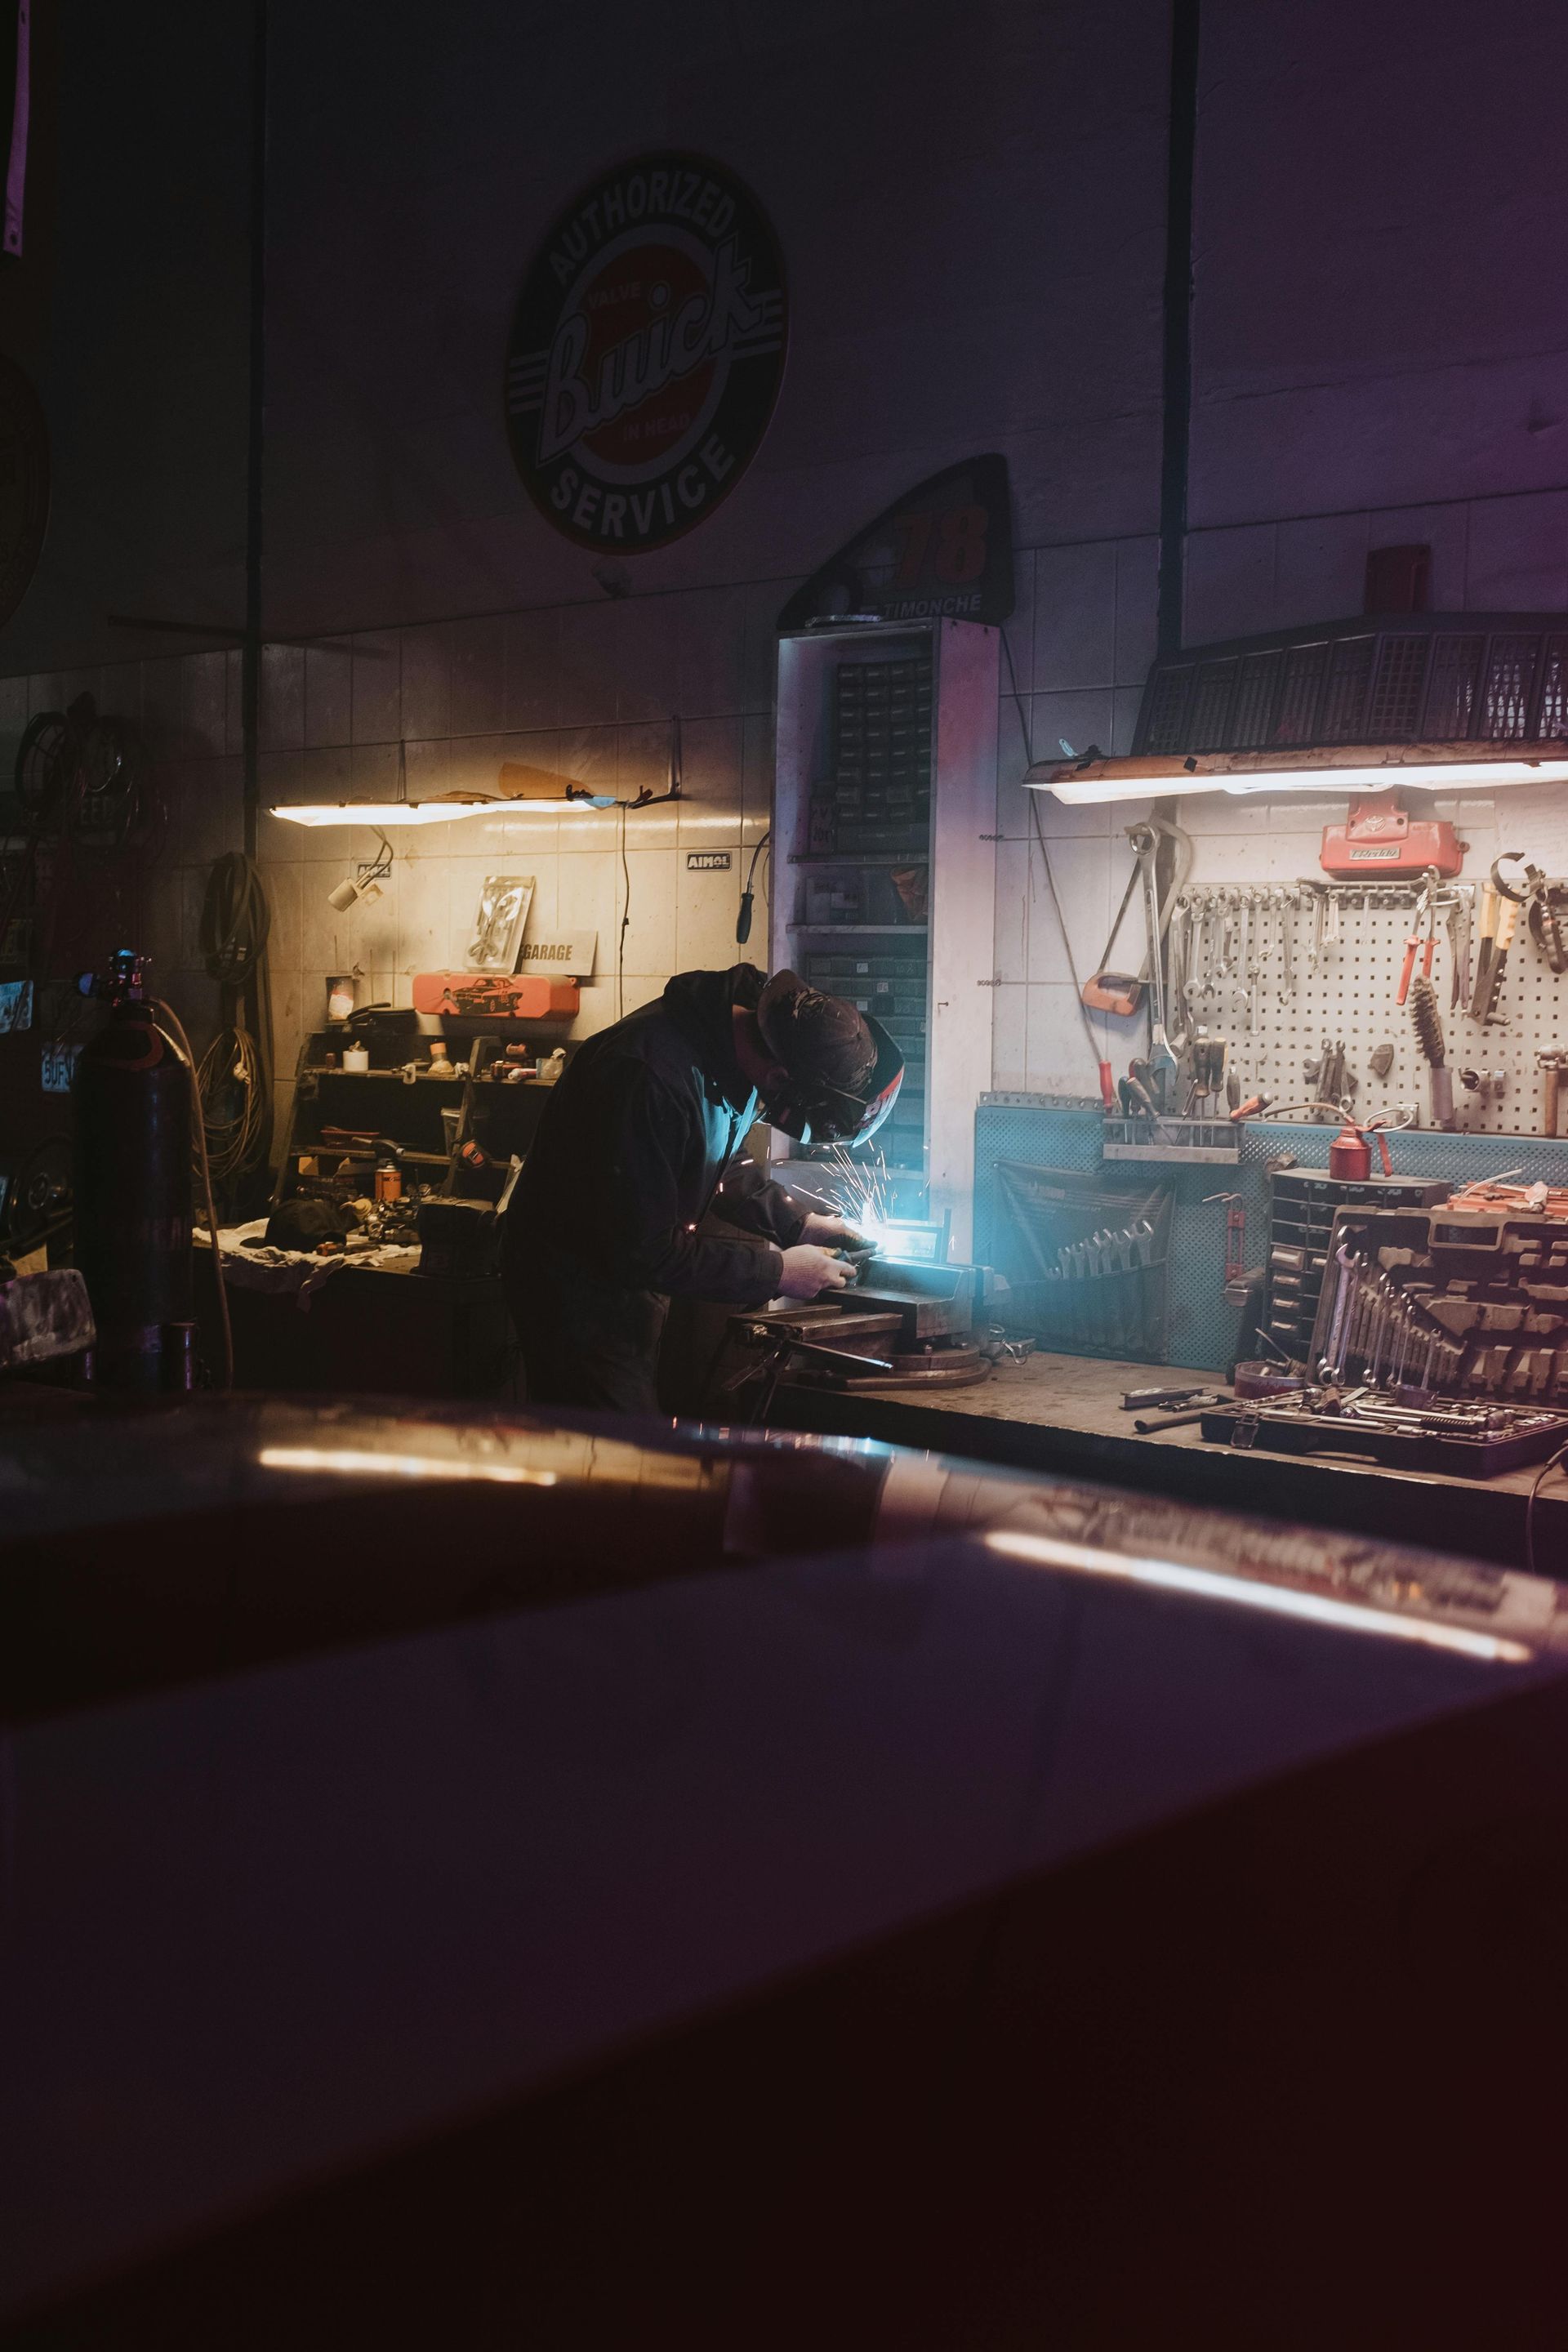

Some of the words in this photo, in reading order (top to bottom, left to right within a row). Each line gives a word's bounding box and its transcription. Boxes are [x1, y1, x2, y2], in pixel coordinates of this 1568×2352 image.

[549, 170, 735, 285] AUTHORIZED
[587, 281, 642, 310] VALVE
[536, 232, 764, 469] Buick
[623, 423, 640, 443] IN
[644, 412, 692, 438] HEAD
[550, 433, 737, 538] SERVICE
[688, 855, 730, 868] AIMOL
